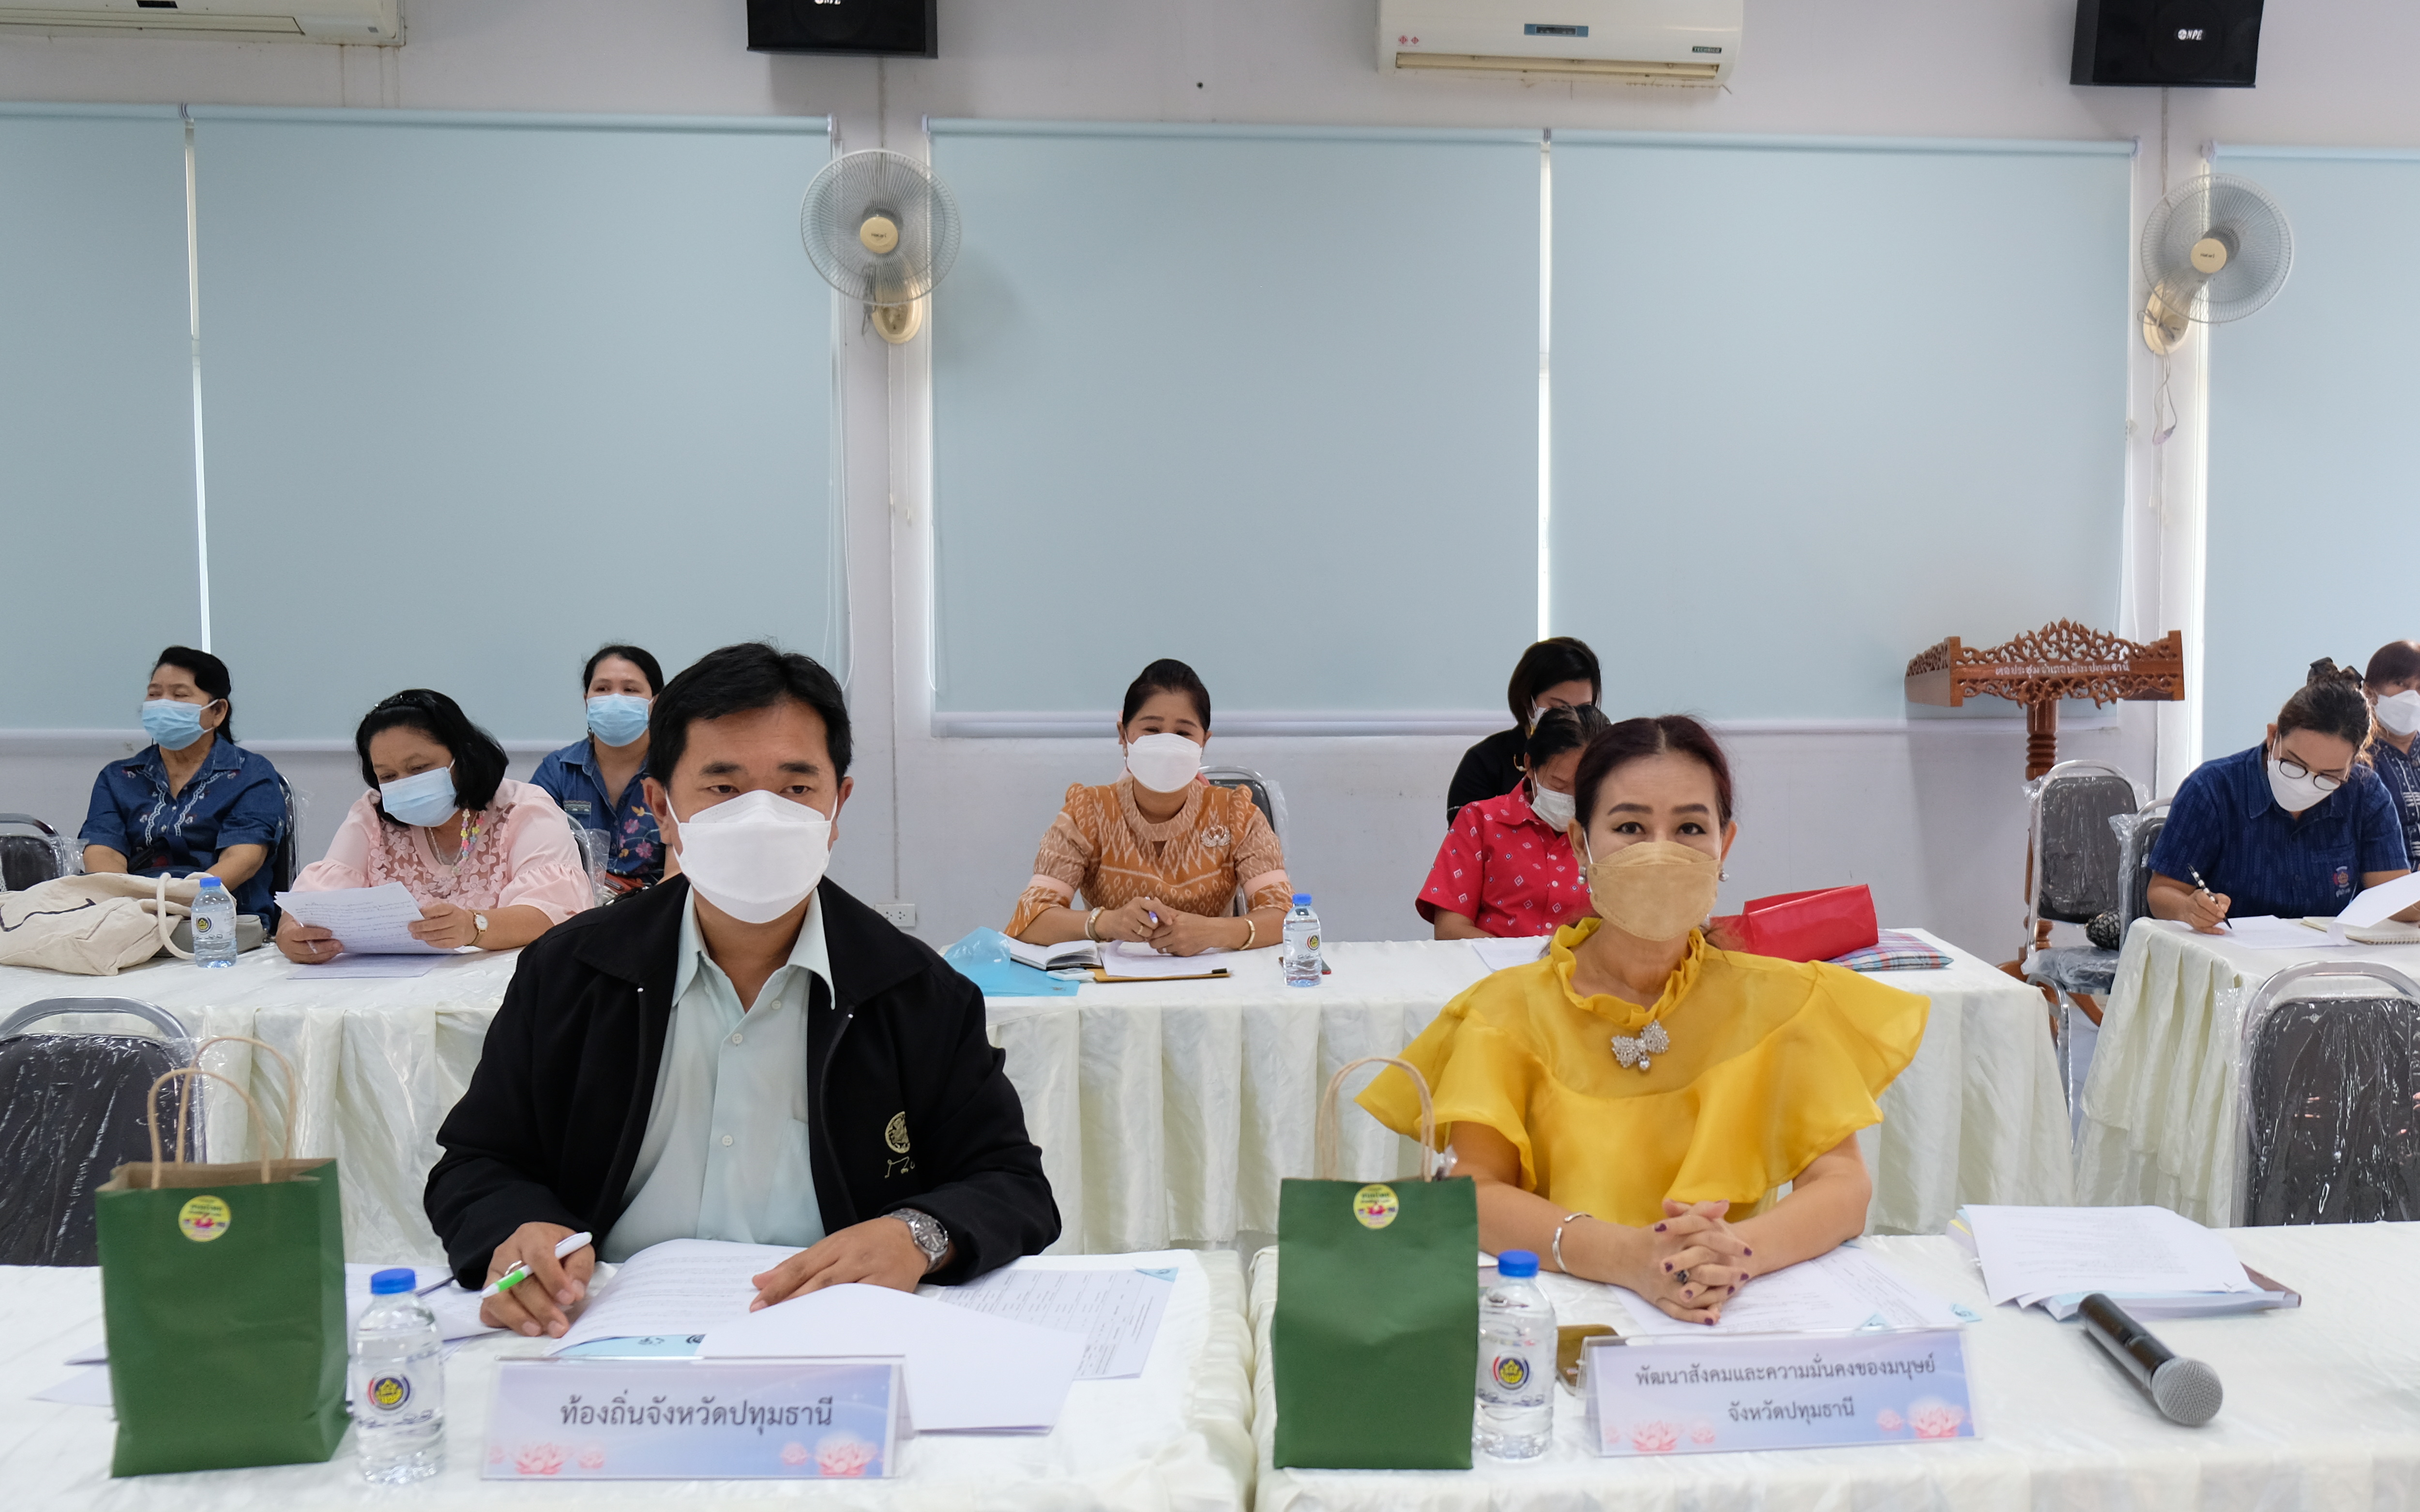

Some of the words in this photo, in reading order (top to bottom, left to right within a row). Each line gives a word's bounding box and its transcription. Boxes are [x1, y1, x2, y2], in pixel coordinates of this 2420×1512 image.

[1635, 1353, 1936, 1386] พัฒนาสังคมและความมั่นคงของมนุษย์
[561, 1390, 833, 1435] ท้องถิ่นจังหวัดปทุมธานี
[1728, 1396, 1855, 1424] จังหวัดปทุมธานี
